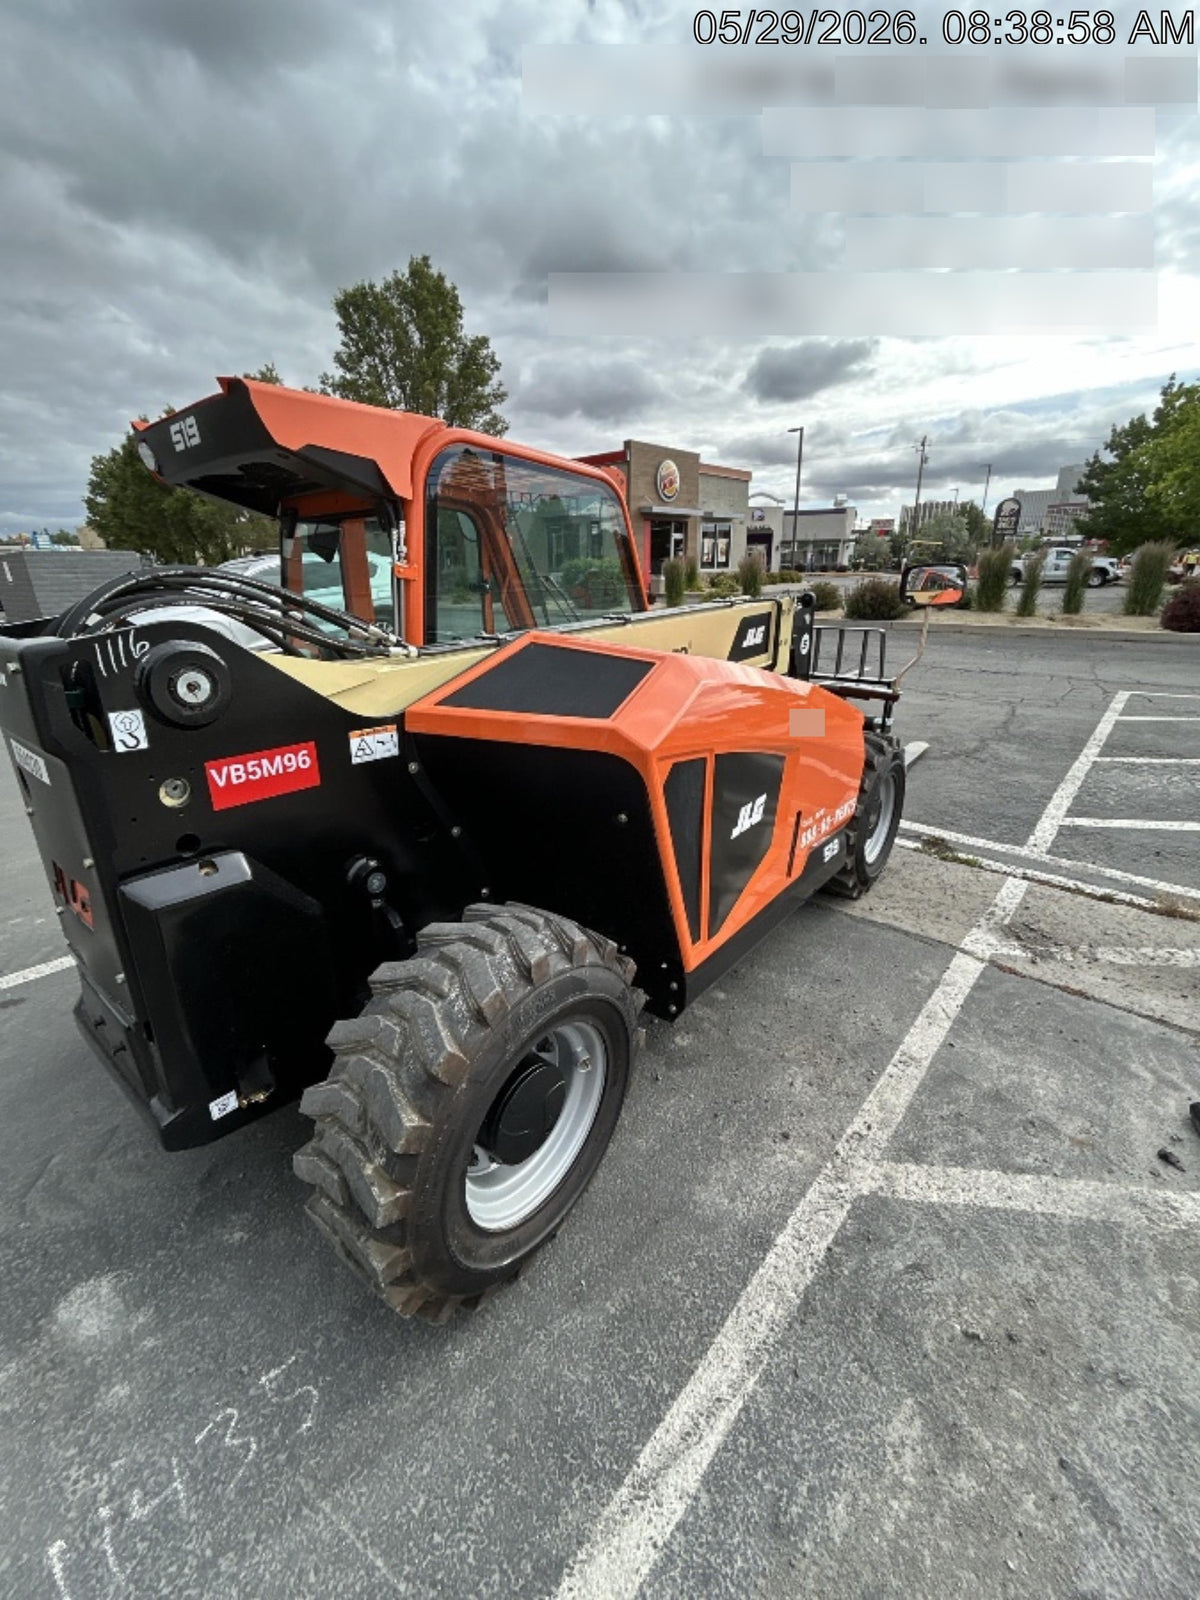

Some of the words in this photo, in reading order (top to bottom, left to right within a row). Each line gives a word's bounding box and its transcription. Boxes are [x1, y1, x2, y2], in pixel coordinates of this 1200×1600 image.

[169, 415, 202, 453] 519
[94, 629, 150, 677] 1116
[742, 625, 766, 648] JLG
[209, 748, 312, 789] VB5M96
[730, 792, 768, 840] JLG
